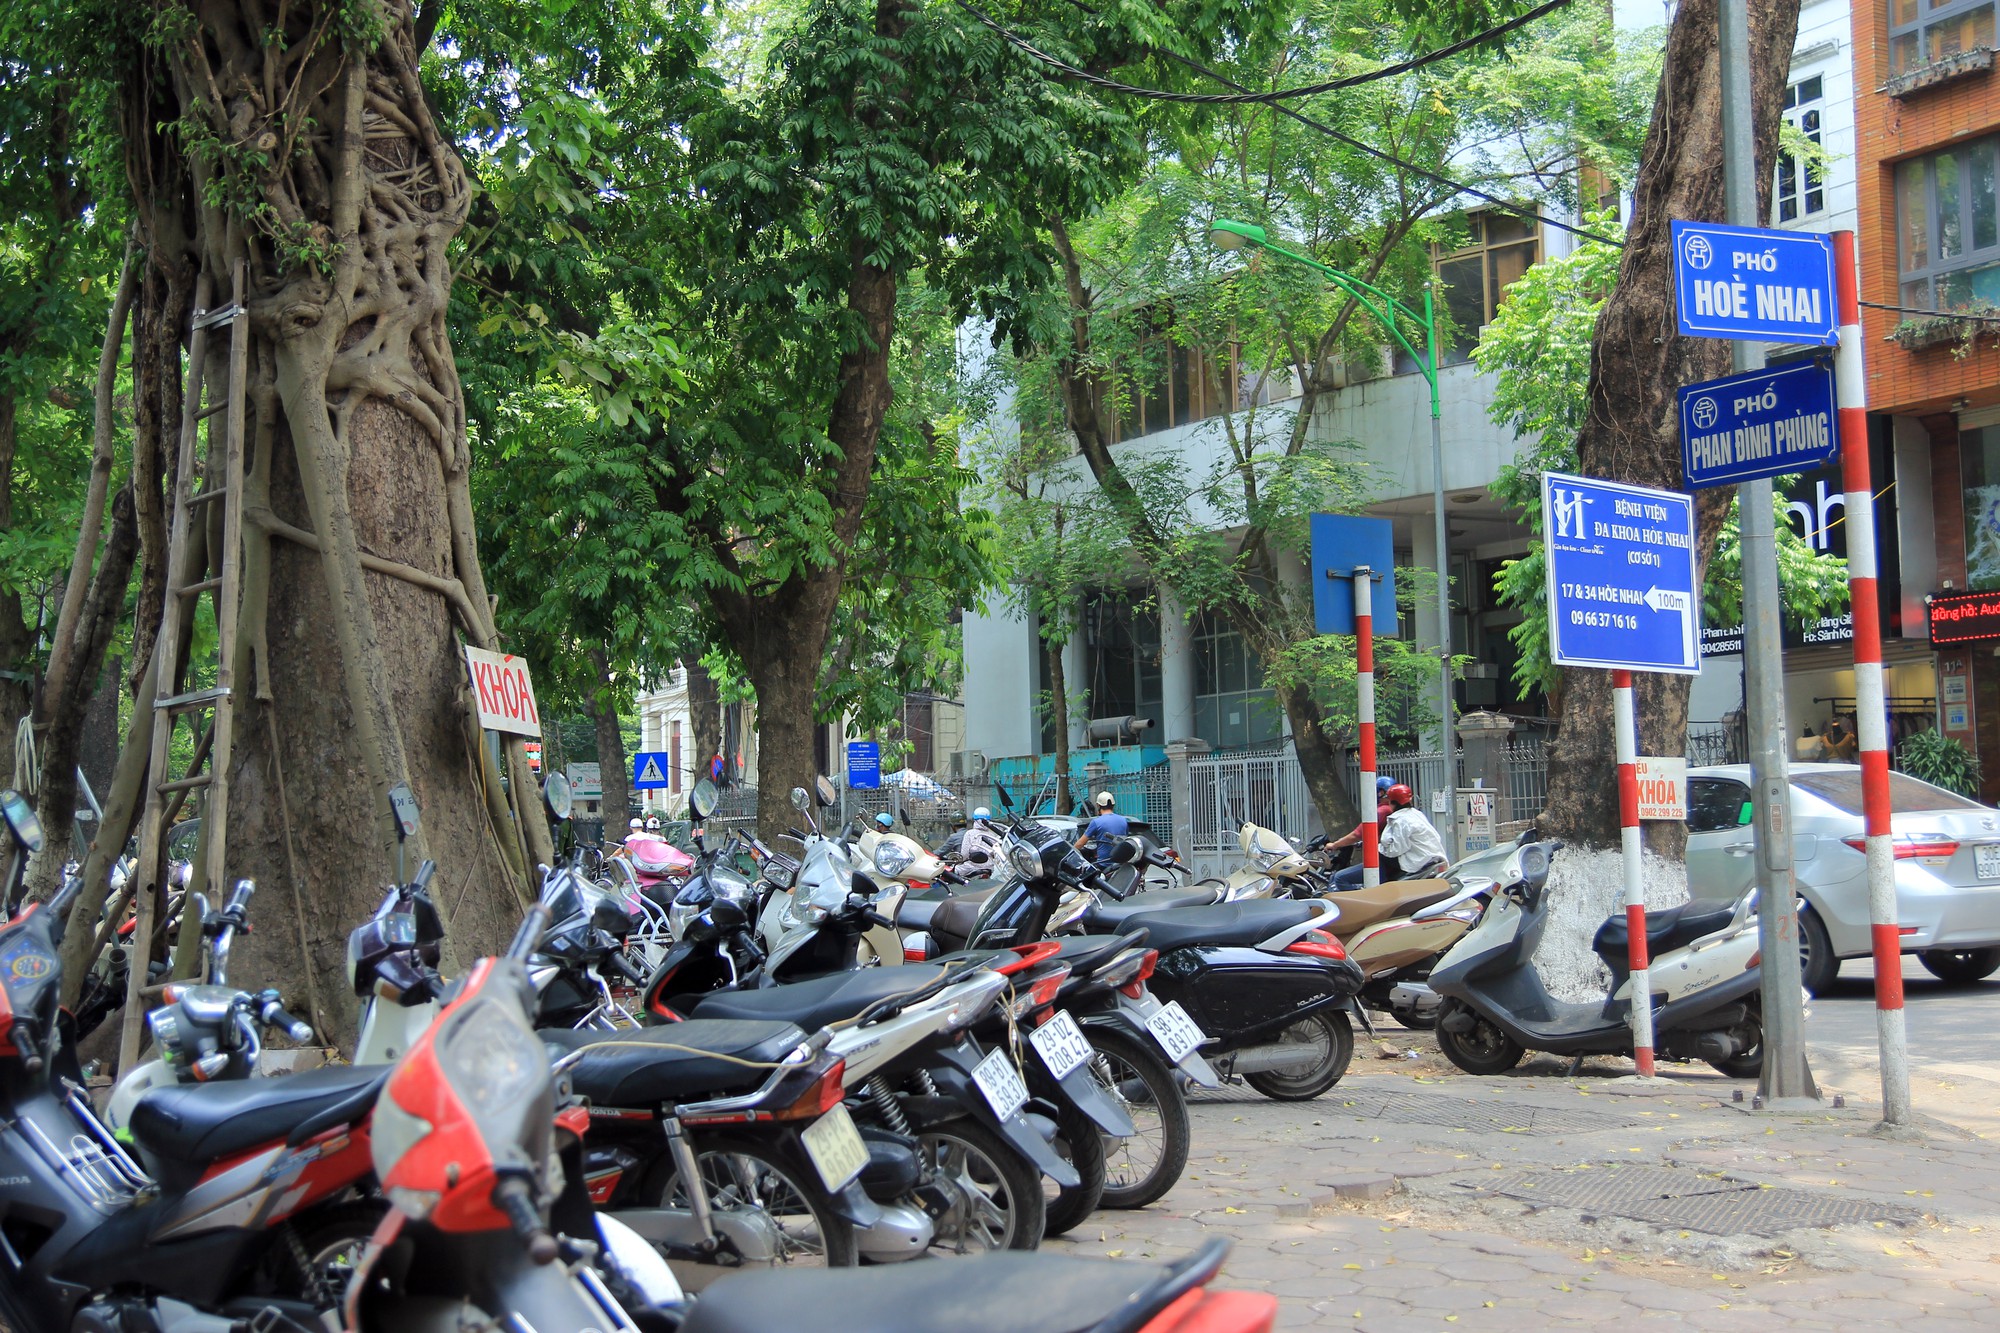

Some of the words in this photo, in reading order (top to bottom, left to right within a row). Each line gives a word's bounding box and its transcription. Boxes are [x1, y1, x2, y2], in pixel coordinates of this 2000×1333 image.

[1732, 248, 1778, 272] PHỐ
[1693, 273, 1748, 319] HOÈ
[1755, 284, 1821, 324] NHAI
[1733, 382, 1777, 416] PHỐ
[1691, 430, 1732, 471] PHAN
[1735, 421, 1771, 462] ĐÌNH
[1774, 409, 1829, 455] PHÙNG
[1614, 498, 1642, 519] BỆNH
[1644, 503, 1667, 523] VIỆN
[1594, 522, 1610, 538] ĐA
[1611, 524, 1641, 542] KHOA
[1642, 526, 1663, 545] HÒE
[1665, 534, 1689, 549] NHAI
[1627, 550, 1641, 566] (CƠ
[1641, 550, 1652, 566] SỞ
[1652, 554, 1660, 568] 1)
[1561, 583, 1573, 598] 17
[1575, 585, 1583, 599] &
[1584, 585, 1597, 600] 34
[1598, 584, 1618, 603] HÒE
[1619, 588, 1643, 606] NHAI
[1657, 592, 1684, 609] 100m
[1571, 610, 1584, 625] 09
[1585, 611, 1597, 626] 66
[1598, 612, 1610, 627] 37
[1612, 614, 1624, 629] 16
[1625, 615, 1637, 630] 16
[1700, 639, 1742, 653] 904285511
[1702, 628, 1723, 639] Phan
[473, 654, 537, 724] KHÓA
[1471, 794, 1485, 805] VA
[1636, 774, 1677, 805] KHÓA
[1473, 806, 1482, 815] XE
[1640, 807, 1657, 817] 0902
[1658, 808, 1670, 817] 299
[1671, 808, 1683, 817] 225
[778, 1029, 803, 1047] HONDA
[1037, 1017, 1073, 1052] 29-D2
[1167, 1024, 1198, 1055] 8977
[1048, 1035, 1090, 1080] 208.42
[979, 1055, 1009, 1090] 89-B1
[991, 1074, 1025, 1118] 259.37
